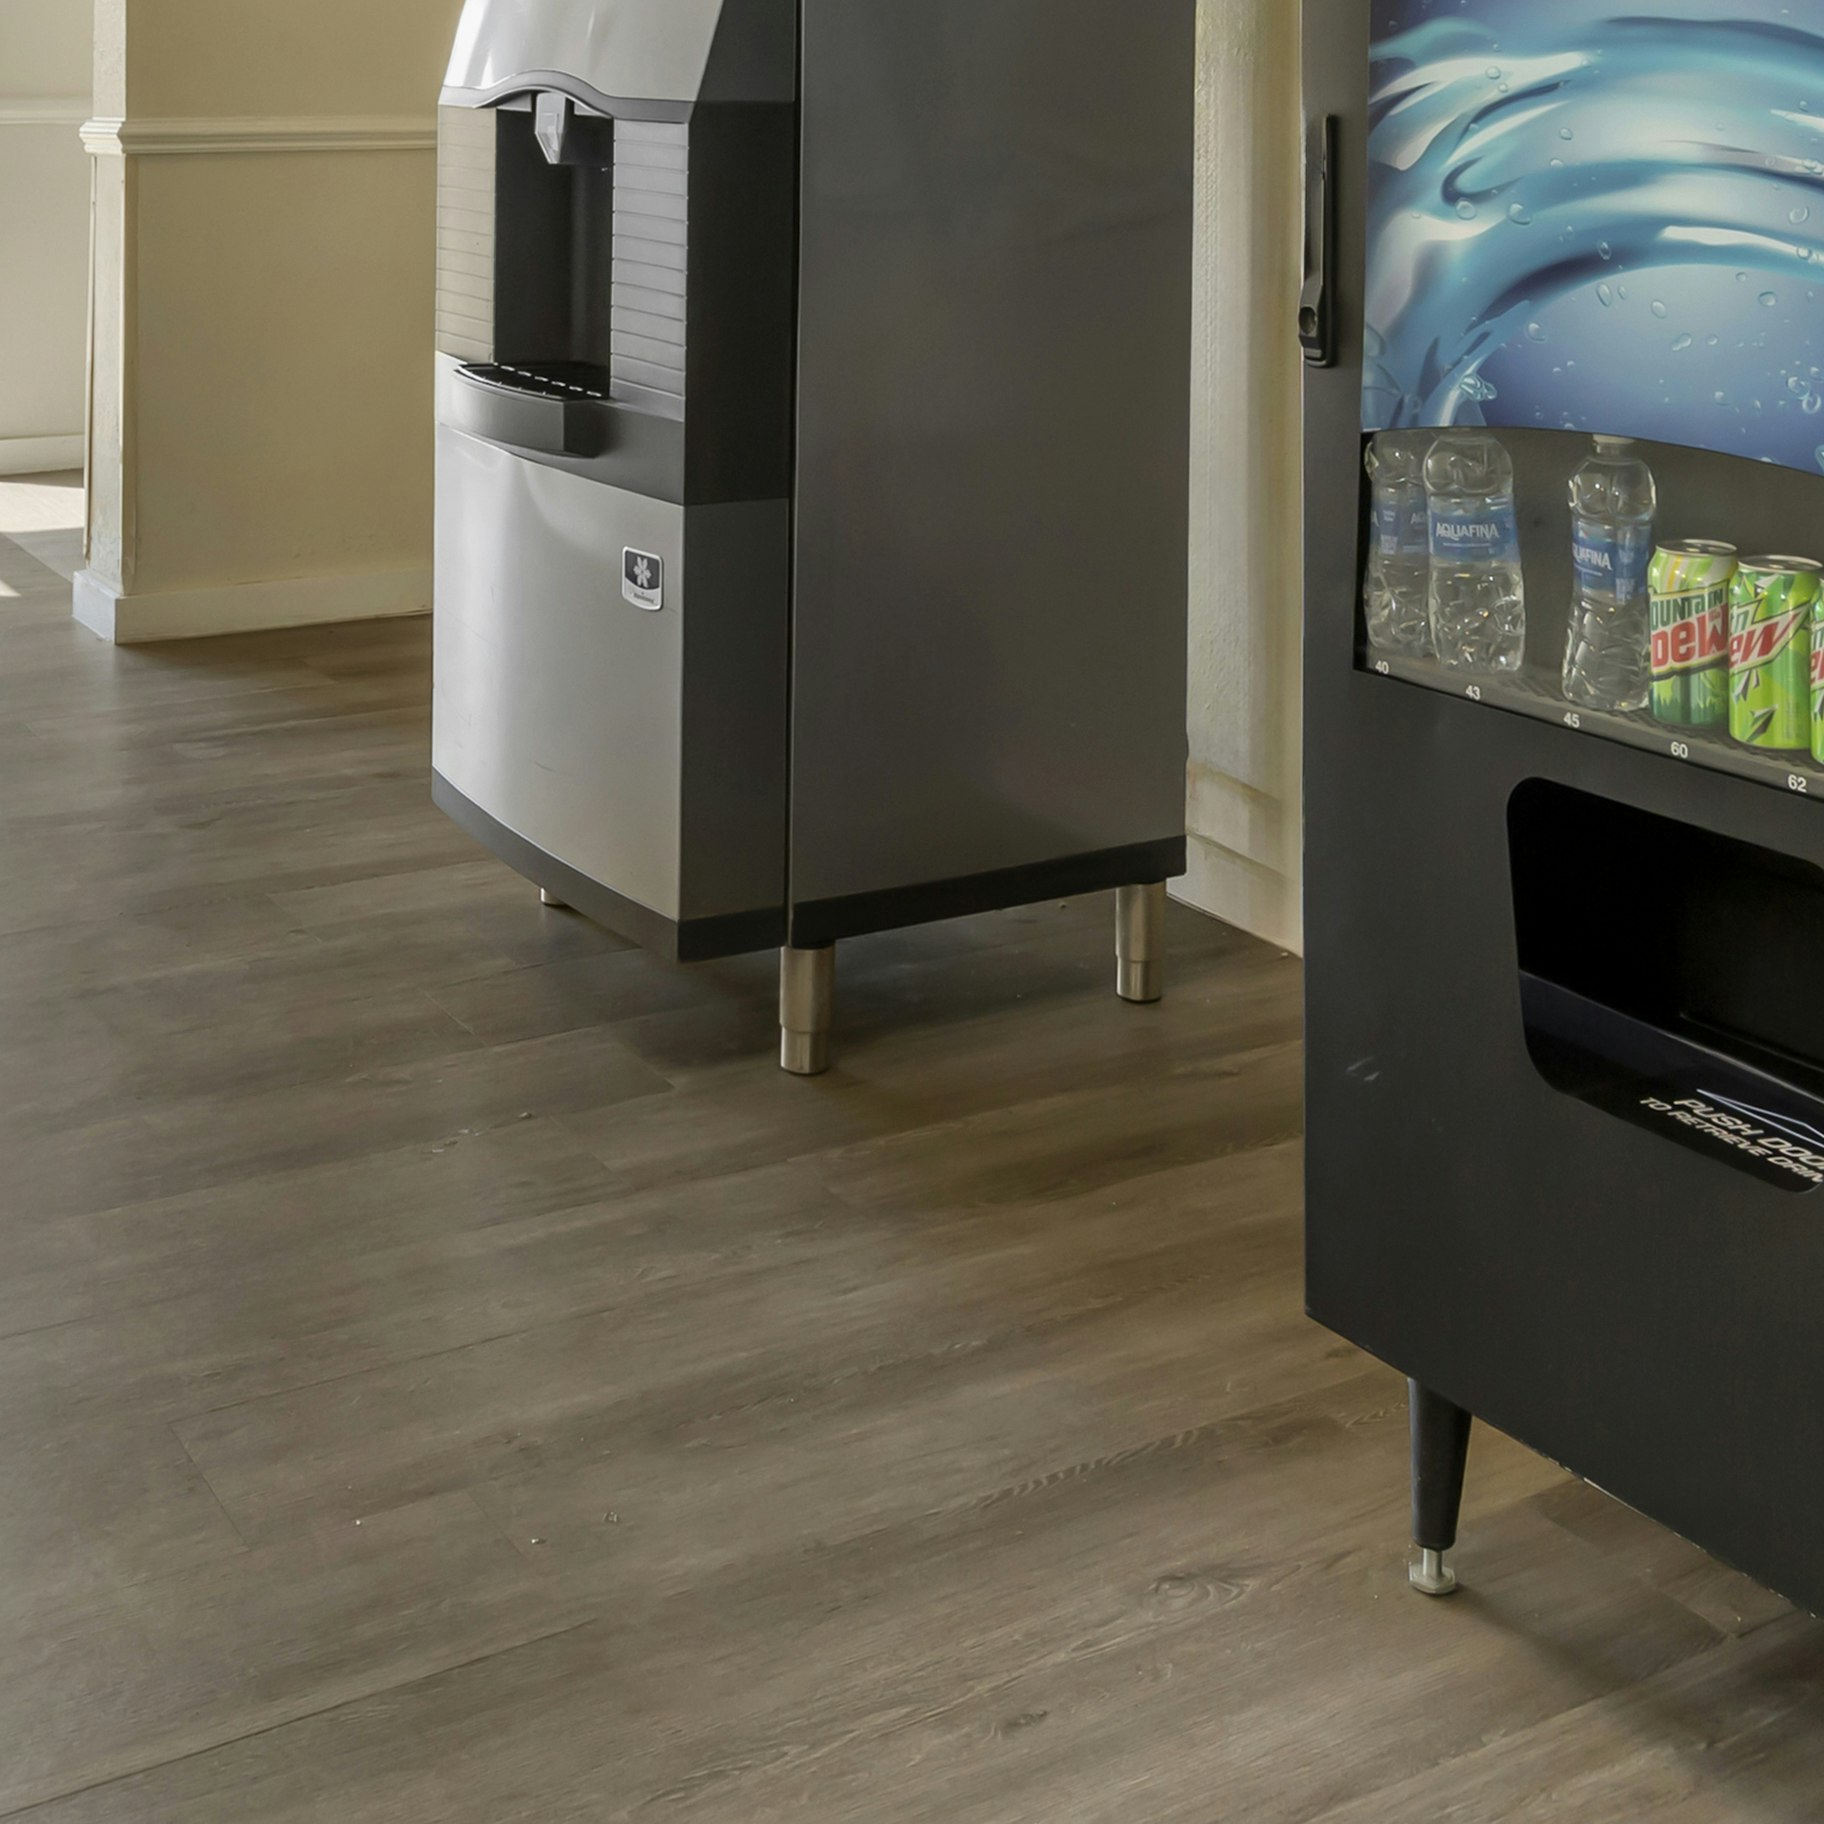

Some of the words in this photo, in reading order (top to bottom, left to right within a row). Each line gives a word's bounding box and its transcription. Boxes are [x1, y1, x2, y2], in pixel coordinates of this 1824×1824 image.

[1436, 522, 1500, 541] AQUAFINA
[1572, 543, 1613, 571] UAFINA
[1375, 660, 1389, 674] 40
[1465, 684, 1481, 701] 43
[1563, 712, 1580, 728] 45
[1670, 741, 1688, 759] 60
[1788, 774, 1807, 793] 62
[1673, 1099, 1764, 1136] PUSH
[1639, 1096, 1673, 1111] TO
[1667, 1110, 1773, 1157] RETRIEVE
[1767, 1156, 1824, 1183] DRIN
